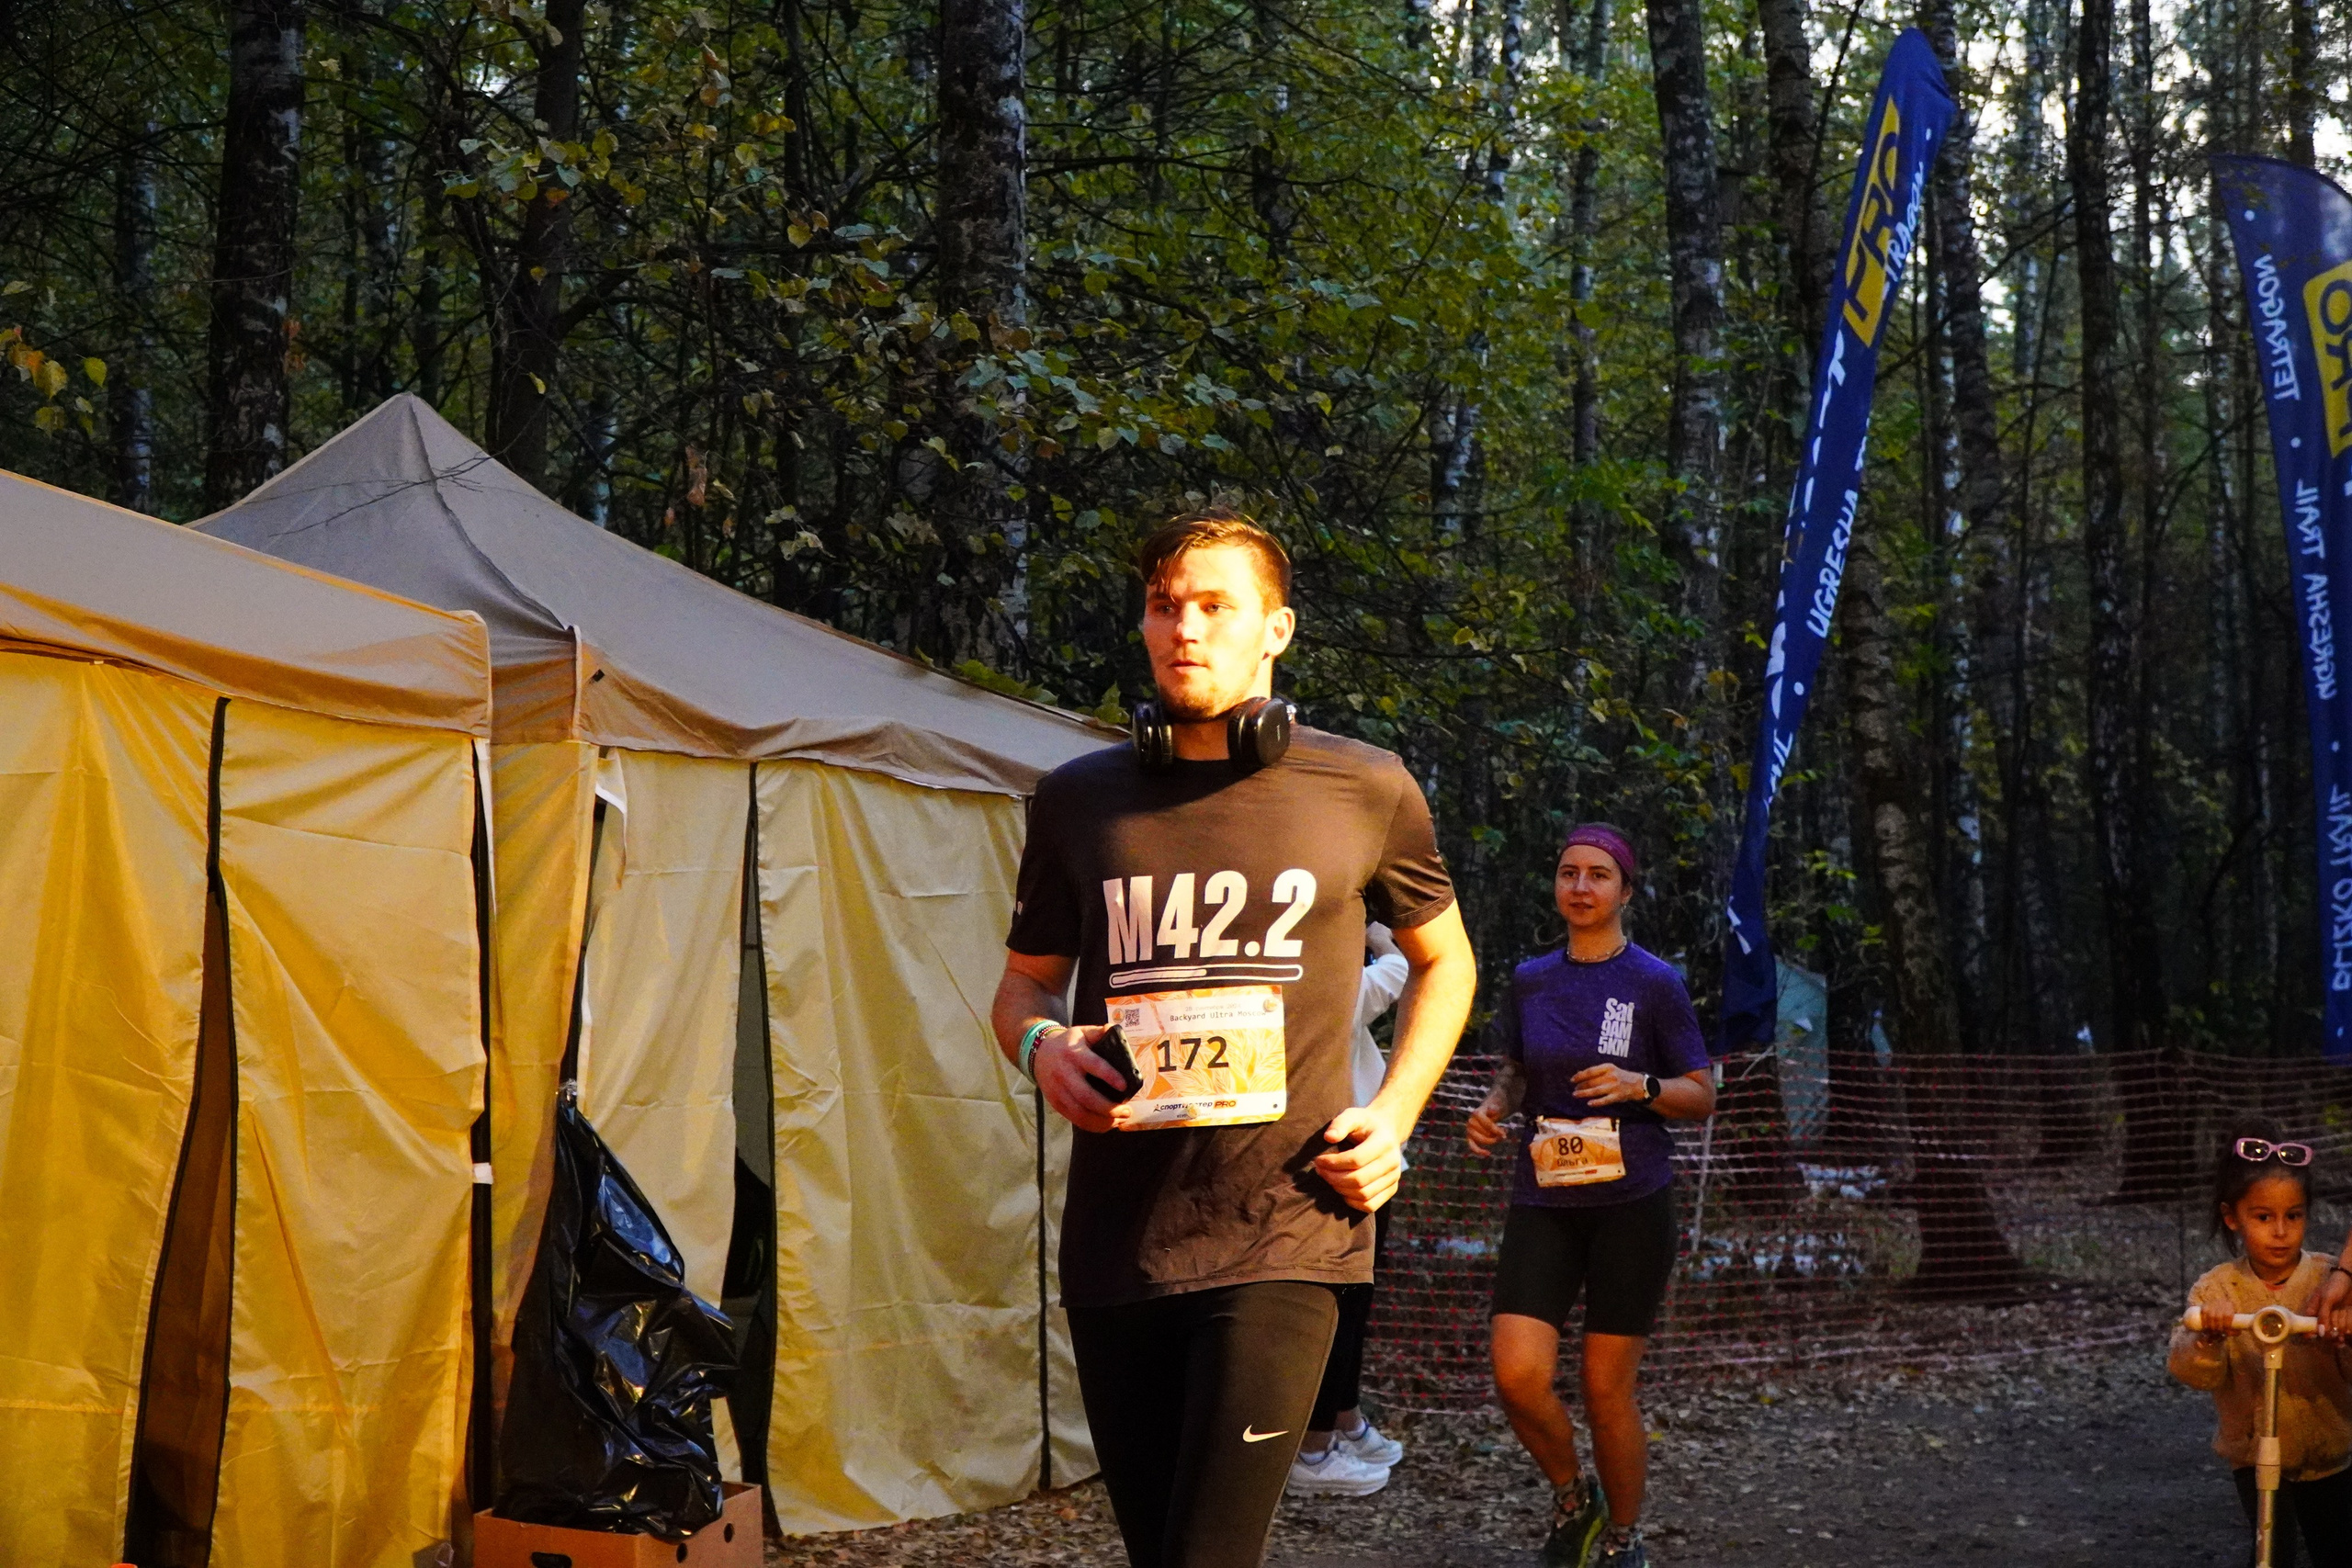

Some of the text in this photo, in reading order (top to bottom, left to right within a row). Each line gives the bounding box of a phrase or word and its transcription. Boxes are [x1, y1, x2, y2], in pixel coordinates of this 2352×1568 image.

[1102, 868, 1317, 966] M42.2
[1170, 1013, 1205, 1021] Backyard
[1604, 998, 1635, 1021] Sat
[1600, 1020, 1633, 1041] 9AM
[1156, 1036, 1229, 1073] 172
[1598, 1036, 1631, 1058] 5KM
[1214, 1100, 1237, 1109] PRO
[1557, 1135, 1583, 1156] 80
